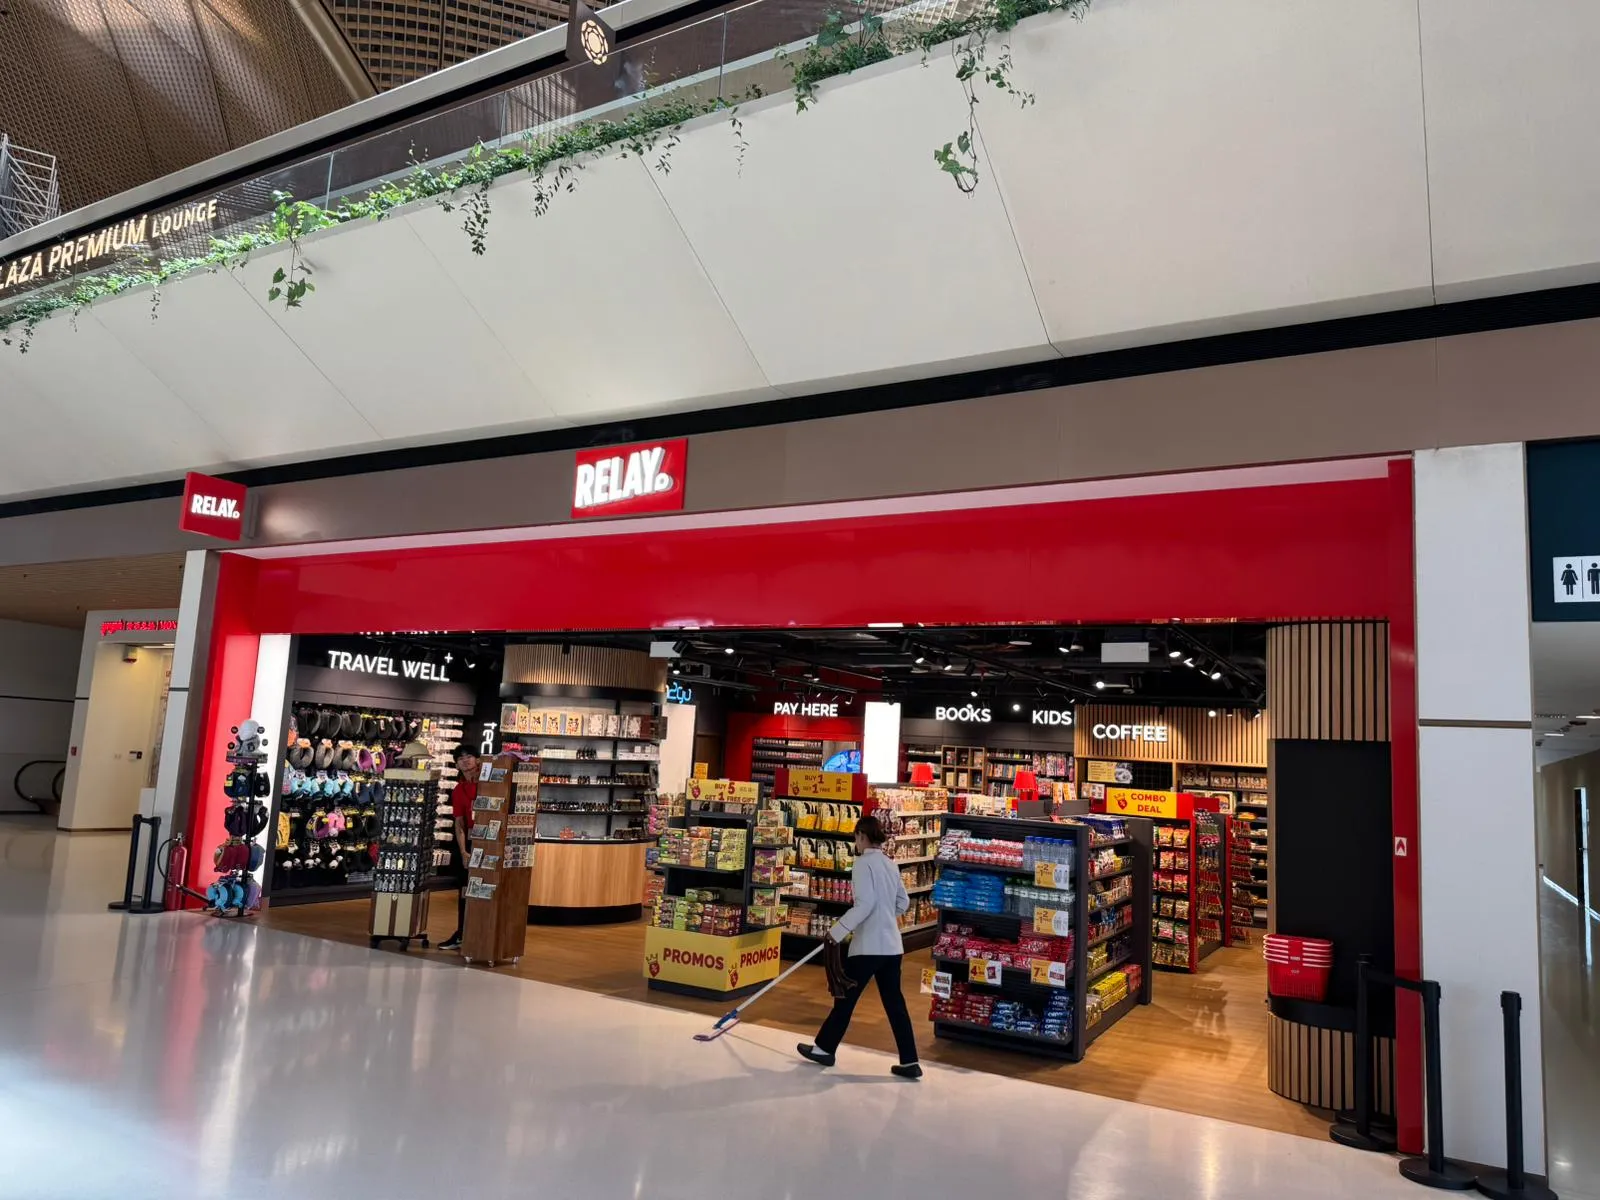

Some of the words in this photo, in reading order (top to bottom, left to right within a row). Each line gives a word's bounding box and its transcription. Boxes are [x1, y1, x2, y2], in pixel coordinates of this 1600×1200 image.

[48, 214, 148, 273] PREMIUM
[152, 199, 217, 239] LOUNGE
[574, 446, 673, 509] RELAY
[191, 493, 241, 519] RELAY
[328, 650, 399, 677] TRAVEL
[773, 702, 799, 716] PAY
[801, 703, 839, 717] HERE
[935, 706, 992, 723] BOOKS
[1032, 710, 1072, 726] KIDS
[1092, 723, 1168, 743] COFFEE
[817, 774, 825, 784] 1
[718, 791, 725, 801] 1
[727, 781, 736, 795] 5
[812, 783, 819, 794] 1
[1131, 793, 1167, 804] COMBO
[1137, 804, 1162, 814] DEAL
[662, 947, 725, 971] PROMOS
[740, 946, 779, 968] PROMOS
[1033, 966, 1041, 977] 7
